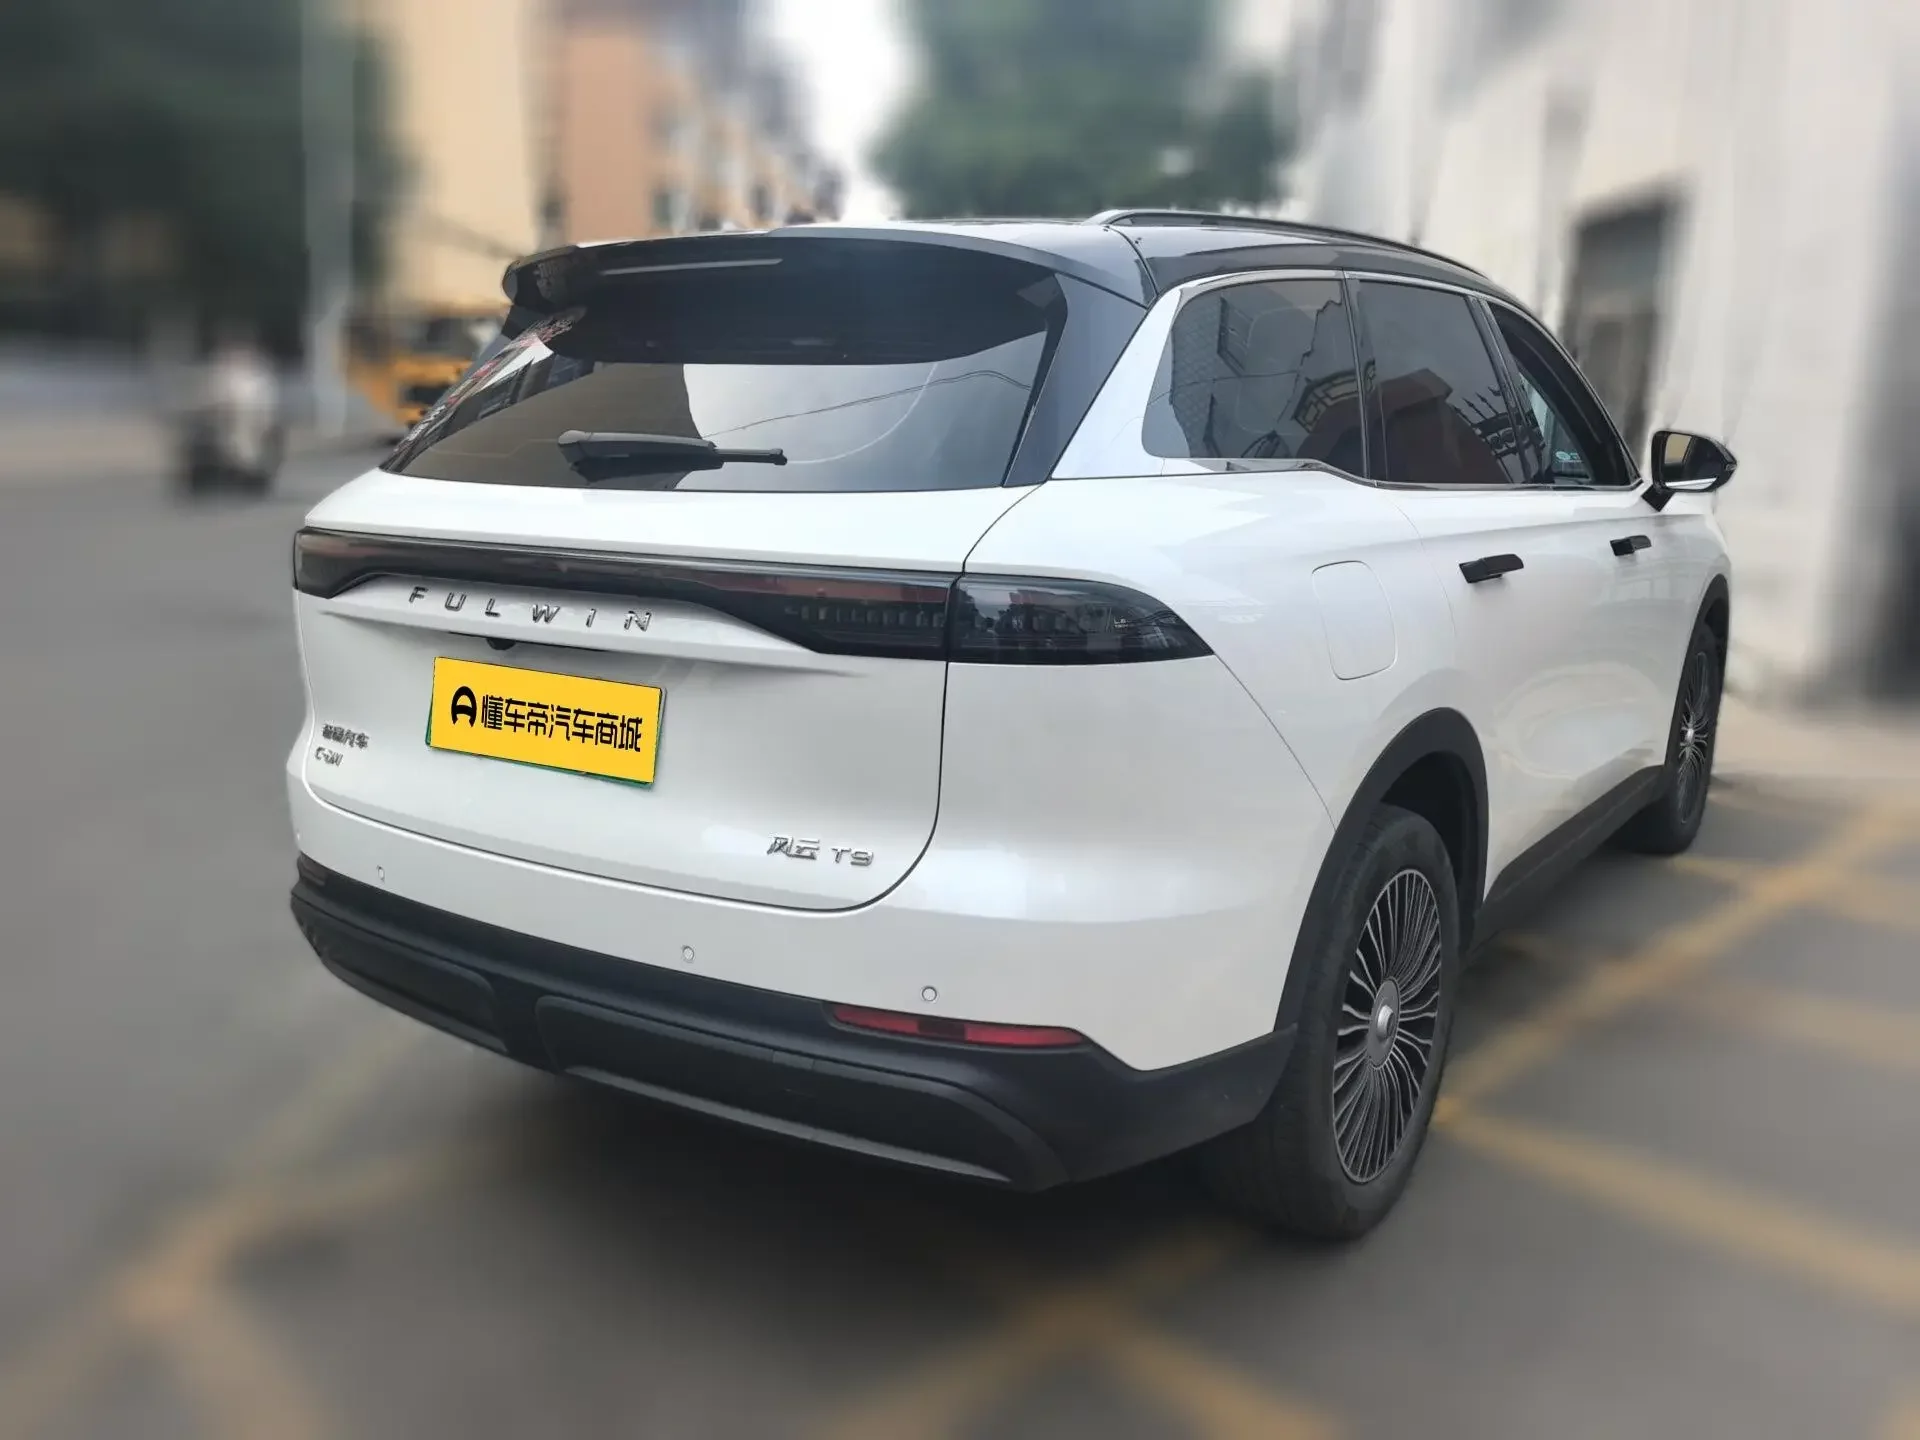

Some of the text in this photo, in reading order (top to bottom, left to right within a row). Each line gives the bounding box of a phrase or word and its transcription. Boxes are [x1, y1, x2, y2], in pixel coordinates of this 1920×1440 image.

[408, 586, 652, 632] FULWIN
[767, 835, 874, 867] 风云 T9
